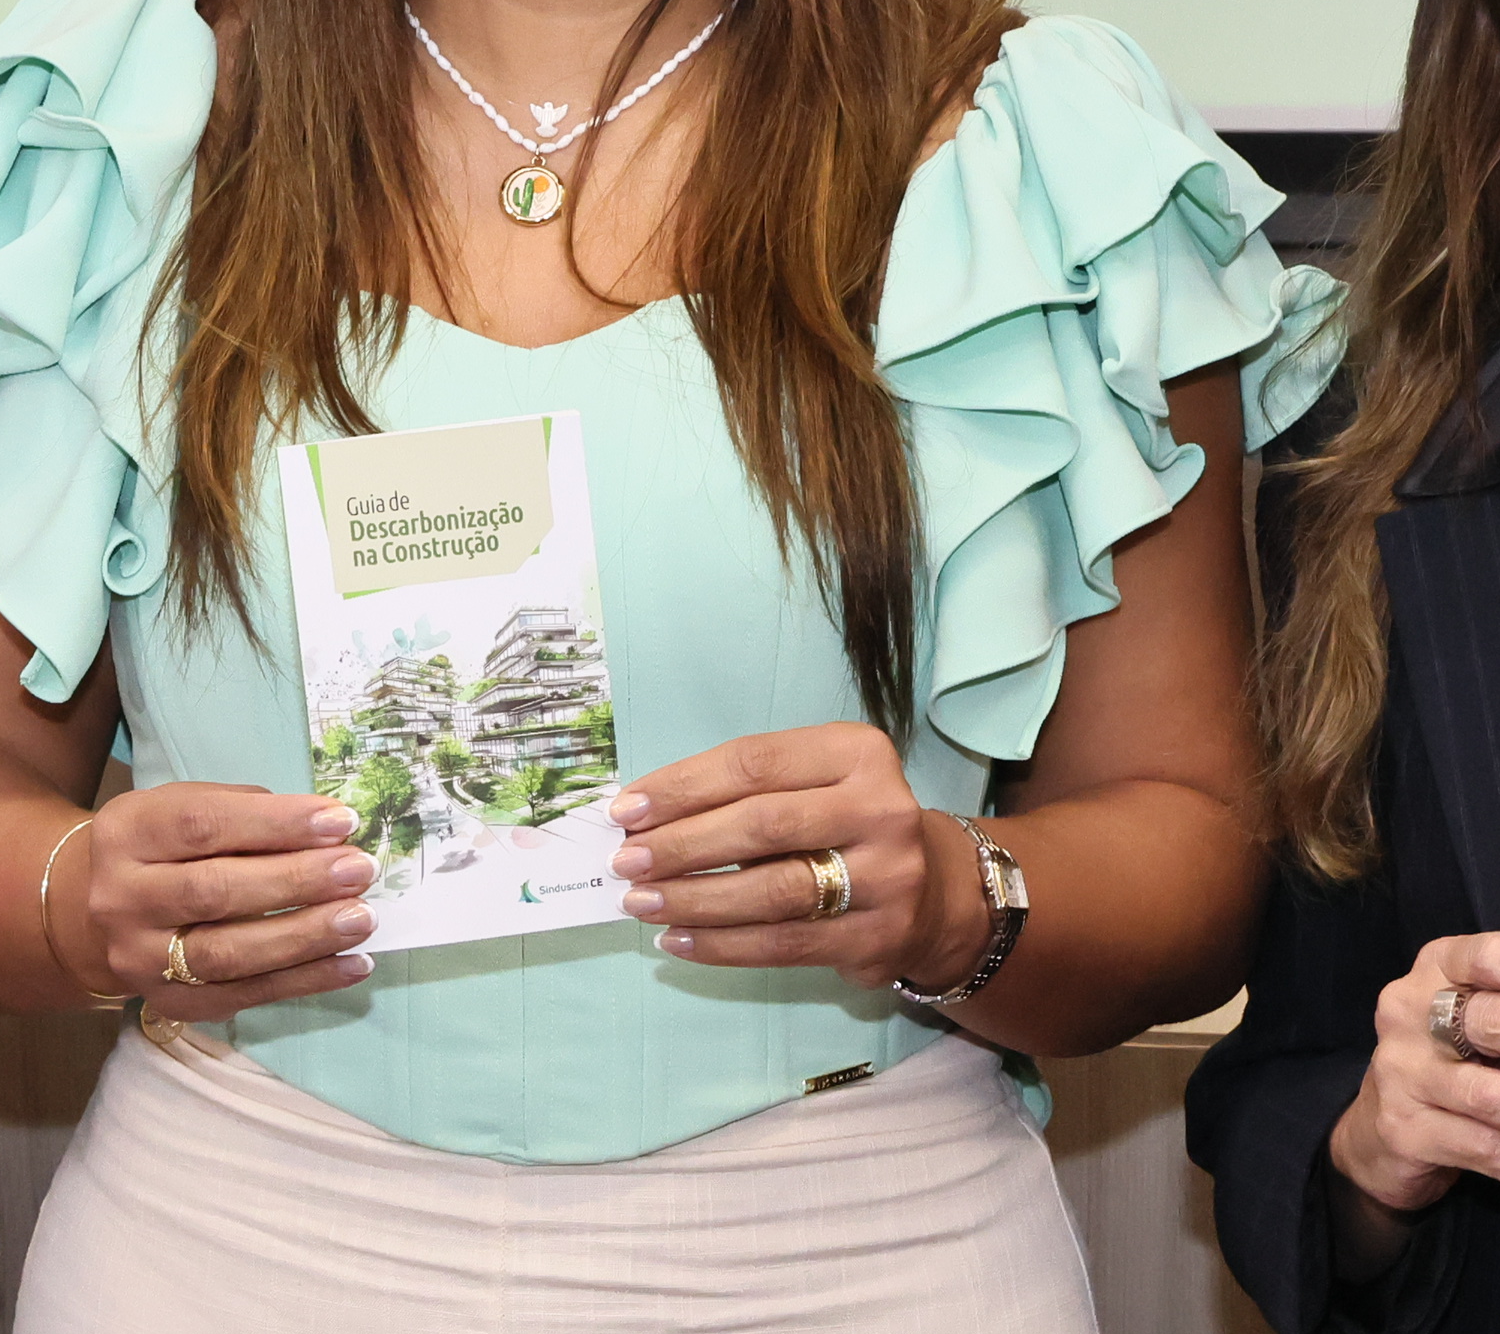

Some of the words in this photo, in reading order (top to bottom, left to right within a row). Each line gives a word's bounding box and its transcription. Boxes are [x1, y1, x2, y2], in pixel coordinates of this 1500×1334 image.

[346, 495, 385, 516] Guia
[388, 491, 409, 511] de
[349, 502, 523, 542] Descarbonização
[352, 547, 378, 567] na
[382, 530, 499, 563] Construção
[539, 880, 588, 895] Sinduscon
[590, 877, 602, 887] CE
